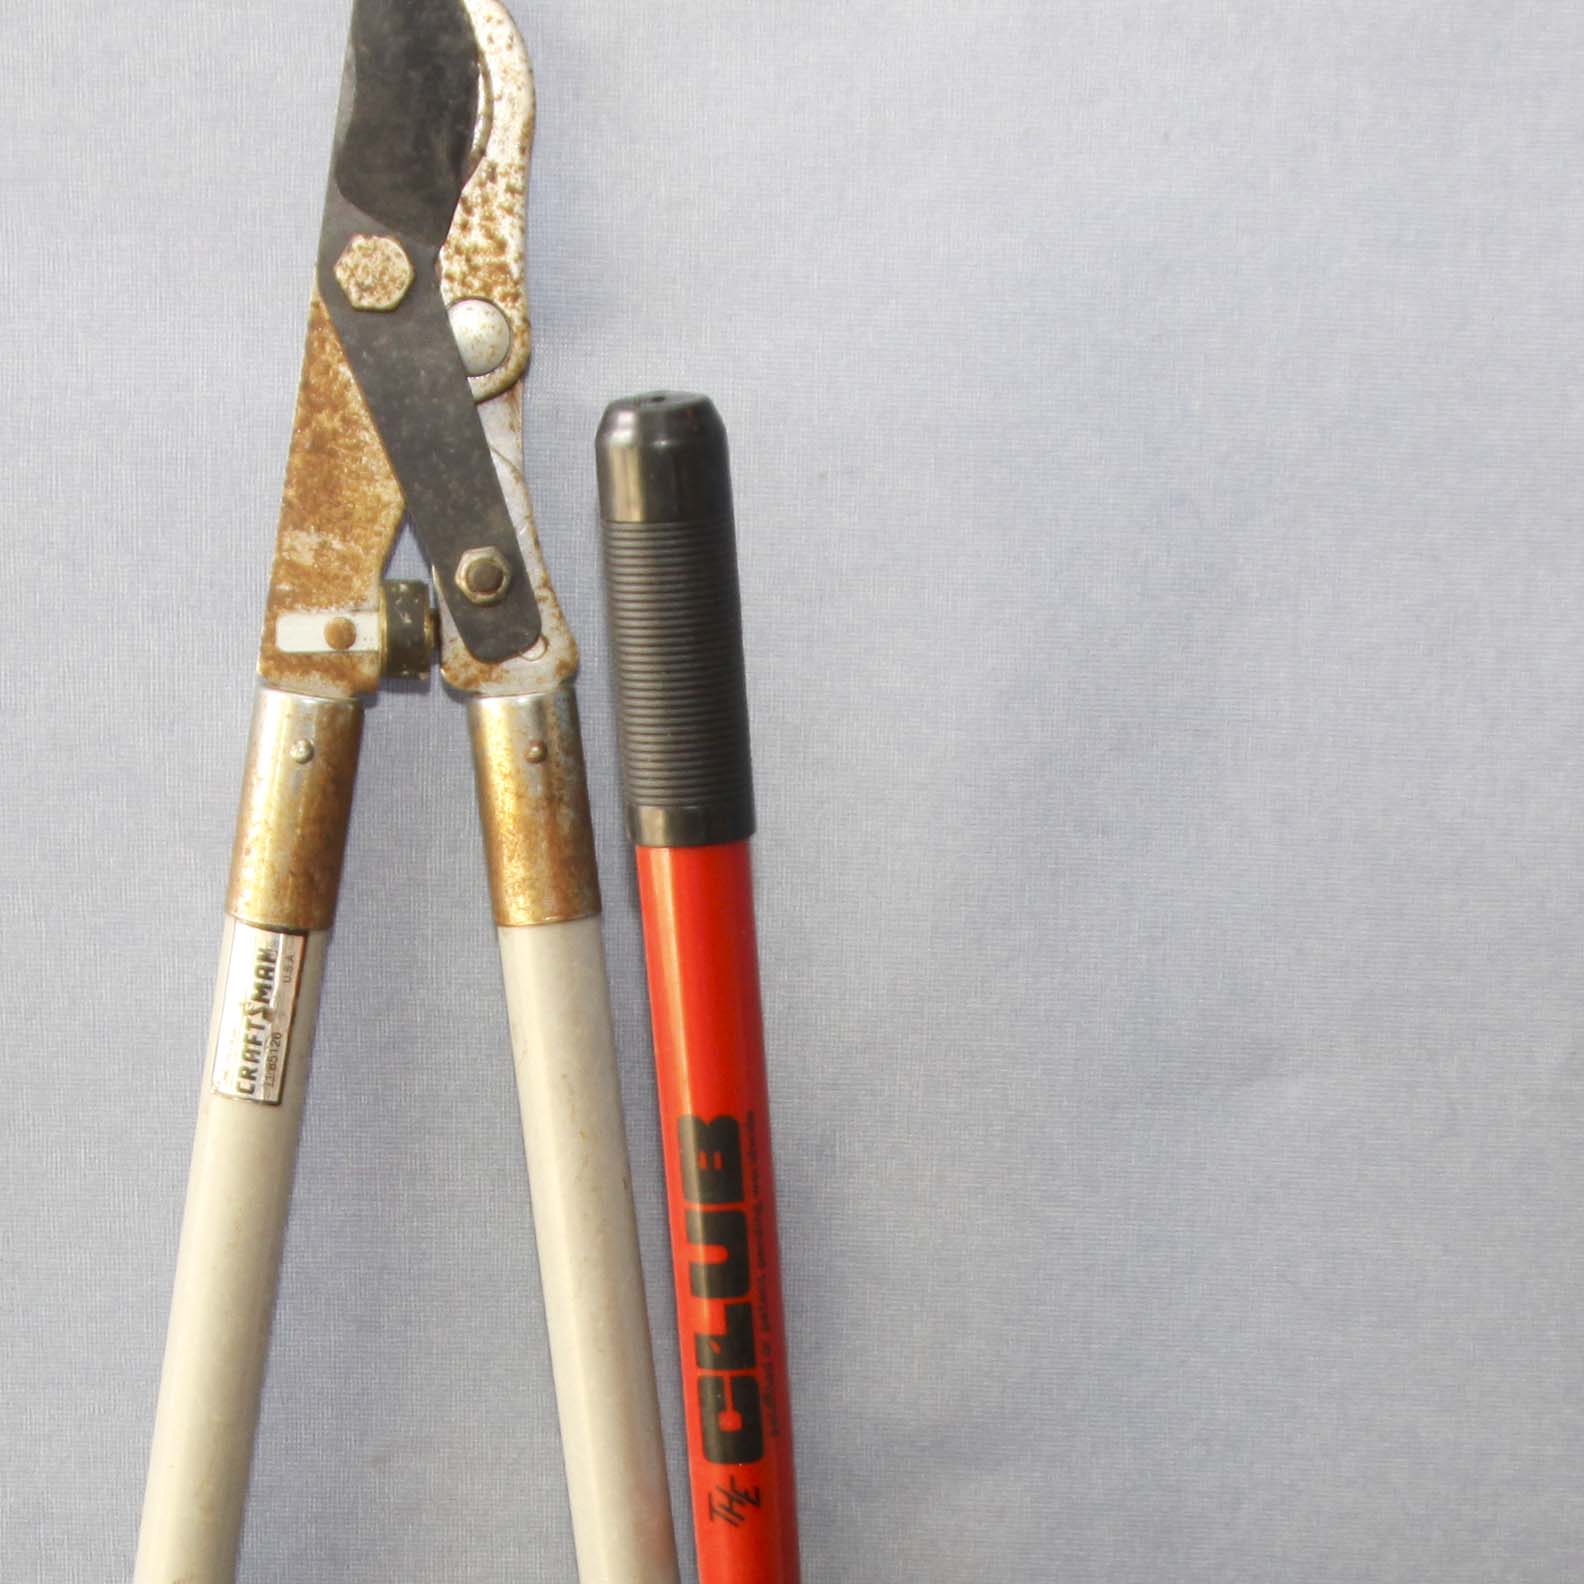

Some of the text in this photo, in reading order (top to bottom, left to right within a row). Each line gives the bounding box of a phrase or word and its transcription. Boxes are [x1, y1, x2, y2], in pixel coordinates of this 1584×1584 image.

[238, 946, 278, 1094] CRAFTSMAN
[680, 1115, 764, 1465] CLUB
[708, 1474, 761, 1528] THE
